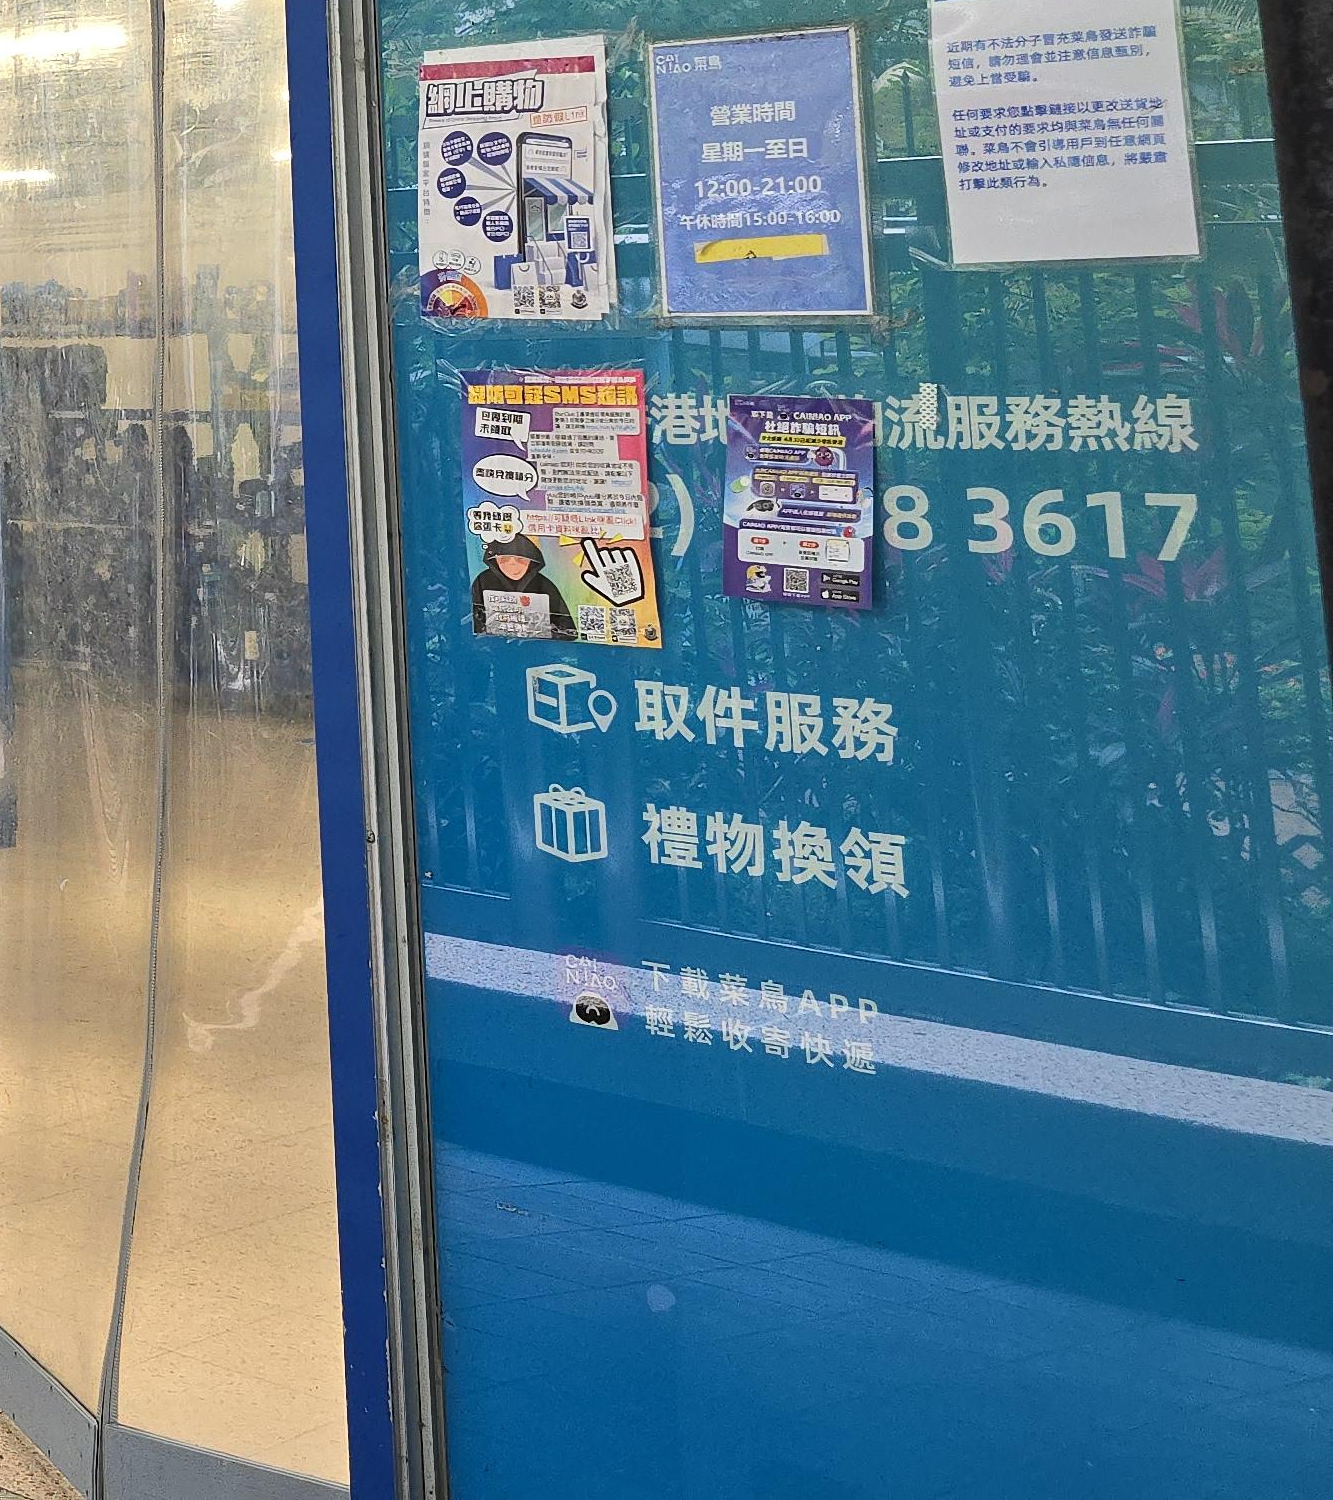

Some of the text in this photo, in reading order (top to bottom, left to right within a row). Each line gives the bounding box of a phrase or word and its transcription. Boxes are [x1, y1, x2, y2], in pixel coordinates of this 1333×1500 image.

[693, 55, 723, 71] 菜鳥
[427, 79, 544, 115] 網上購物
[710, 101, 796, 127] 營業時間
[701, 138, 808, 164] 星期一至日
[695, 175, 822, 199] 12:00-21:00
[833, 413, 852, 422] APP
[873, 394, 1199, 453] 流服務熱線
[966, 486, 1199, 562] 3617
[634, 679, 898, 764] 取件服務
[642, 803, 910, 898] 禮物換領
[641, 959, 879, 1025] 下載菜鳥APP
[643, 1004, 878, 1076] 輕鬆收寄快遞
